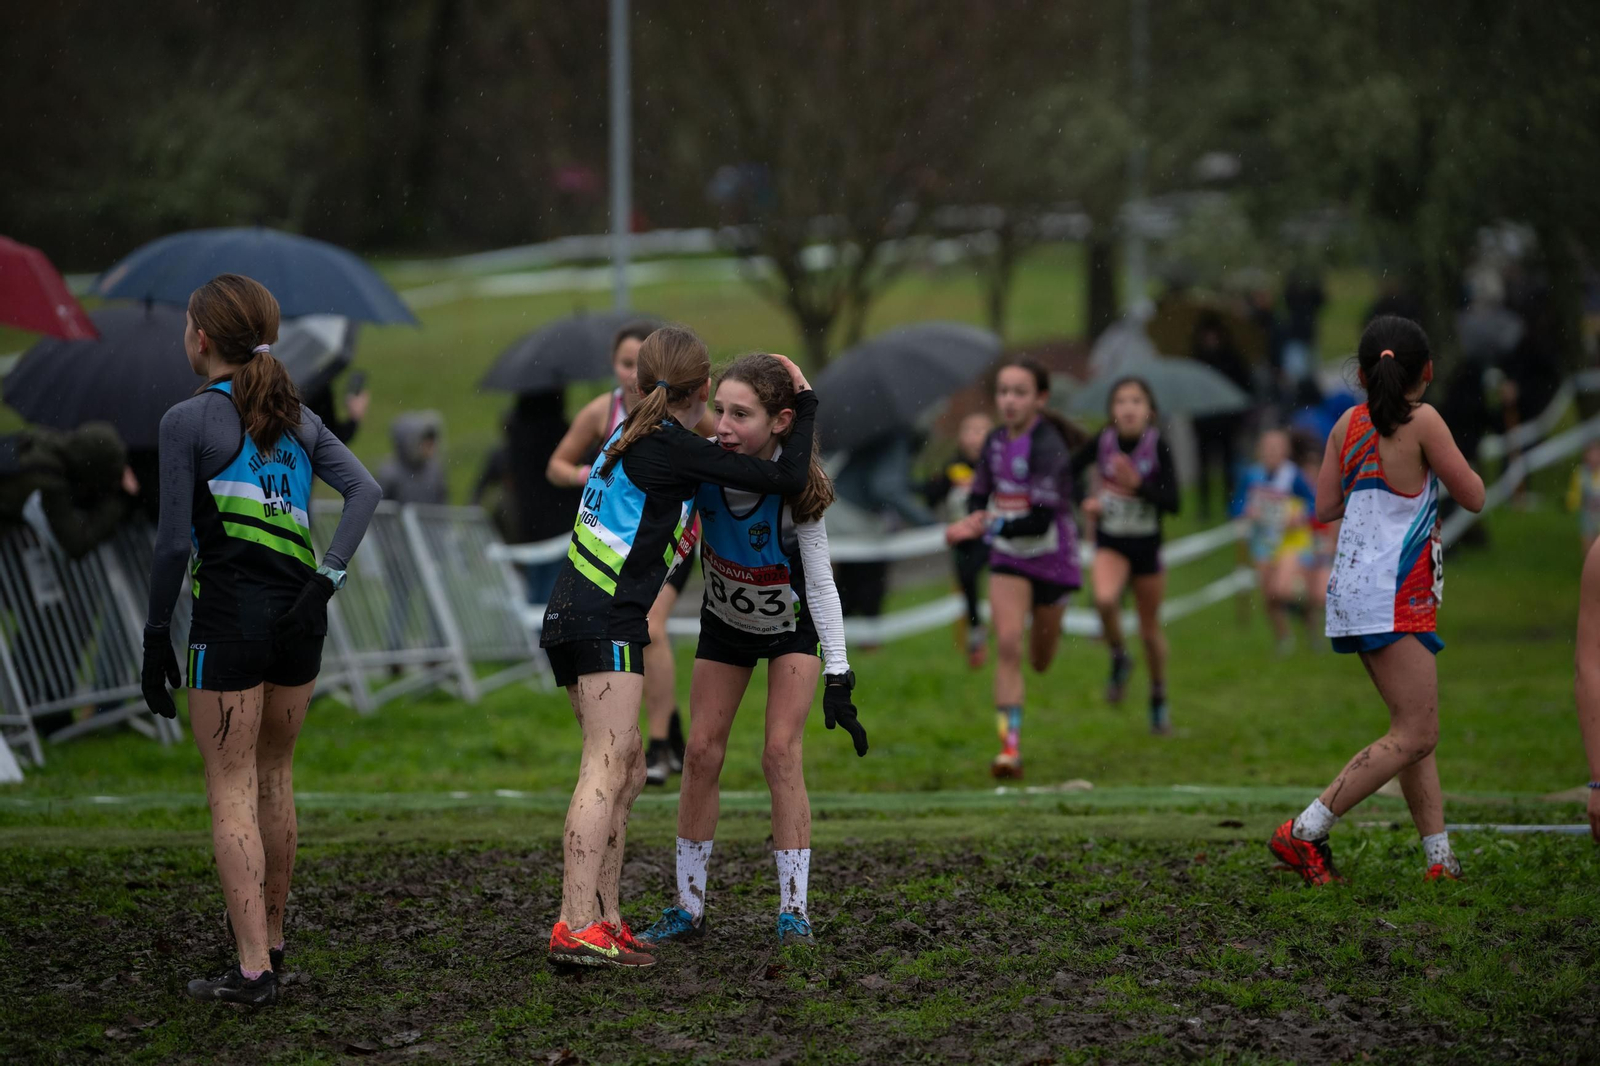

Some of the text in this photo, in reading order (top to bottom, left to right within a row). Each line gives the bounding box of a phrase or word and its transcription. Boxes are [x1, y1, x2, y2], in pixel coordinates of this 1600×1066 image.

[263, 502, 278, 518] DE
[756, 571, 787, 583] 2026
[709, 571, 786, 617] 863
